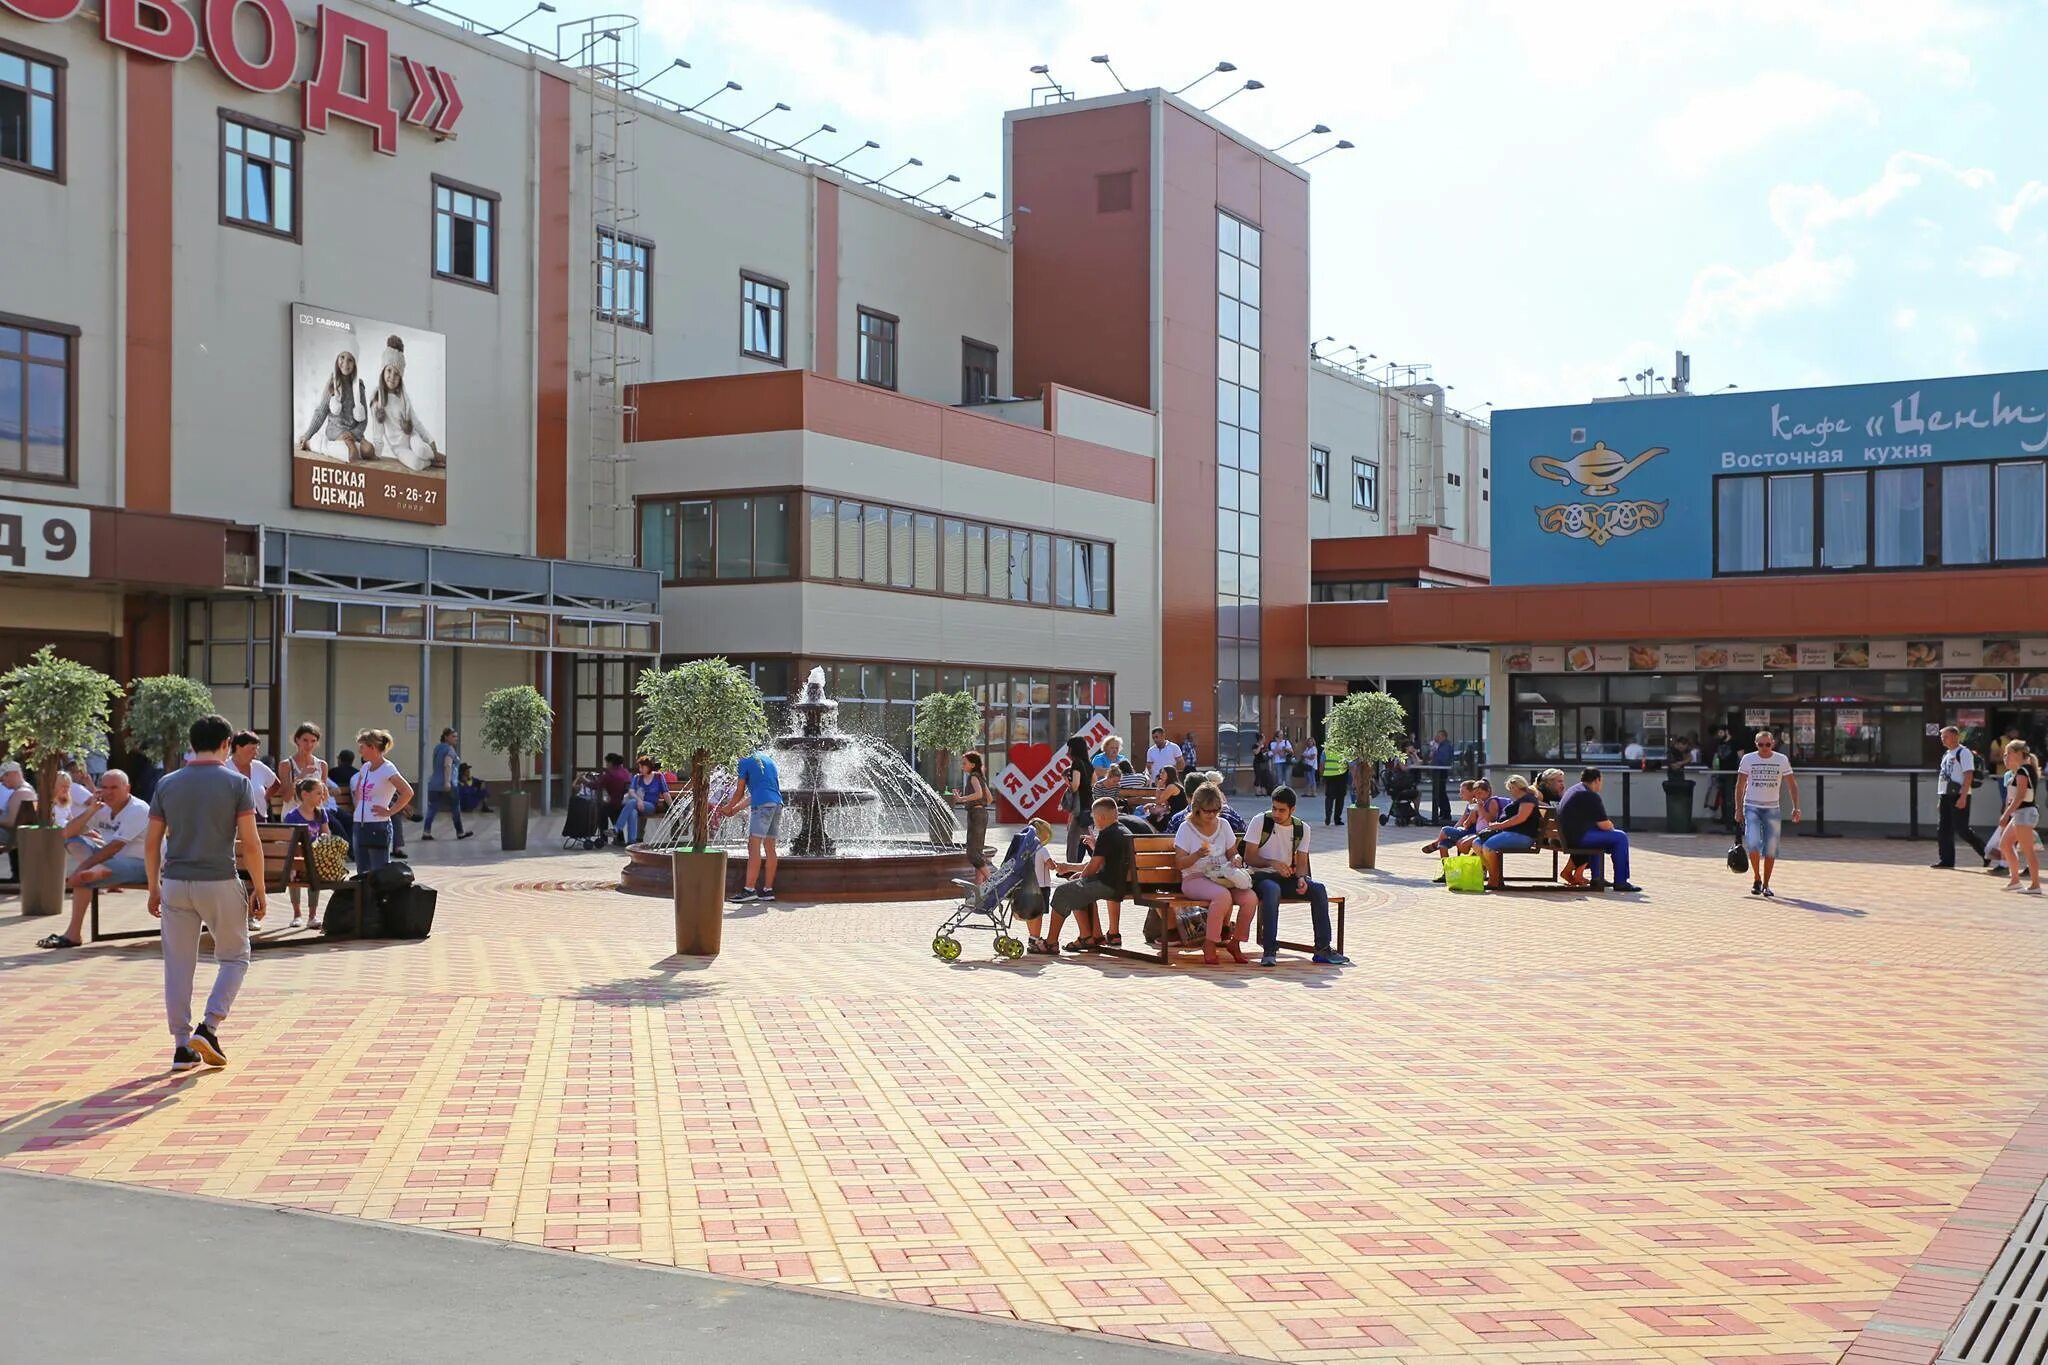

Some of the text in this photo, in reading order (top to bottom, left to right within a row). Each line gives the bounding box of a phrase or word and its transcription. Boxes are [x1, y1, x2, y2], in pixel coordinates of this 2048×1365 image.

[1770, 402, 1851, 447] Кафе
[1721, 443, 1932, 469] Восточная кухня
[311, 466, 366, 489] ДЕТСКАЯ
[312, 485, 365, 509] ОДЕЖДА
[384, 484, 397, 499] 25
[424, 490, 437, 504] 27
[42, 518, 77, 562] 9
[1943, 690, 2004, 700] ЛЕПЕШКИ
[1019, 721, 1111, 810] САДООД
[1003, 772, 1024, 795] Я
